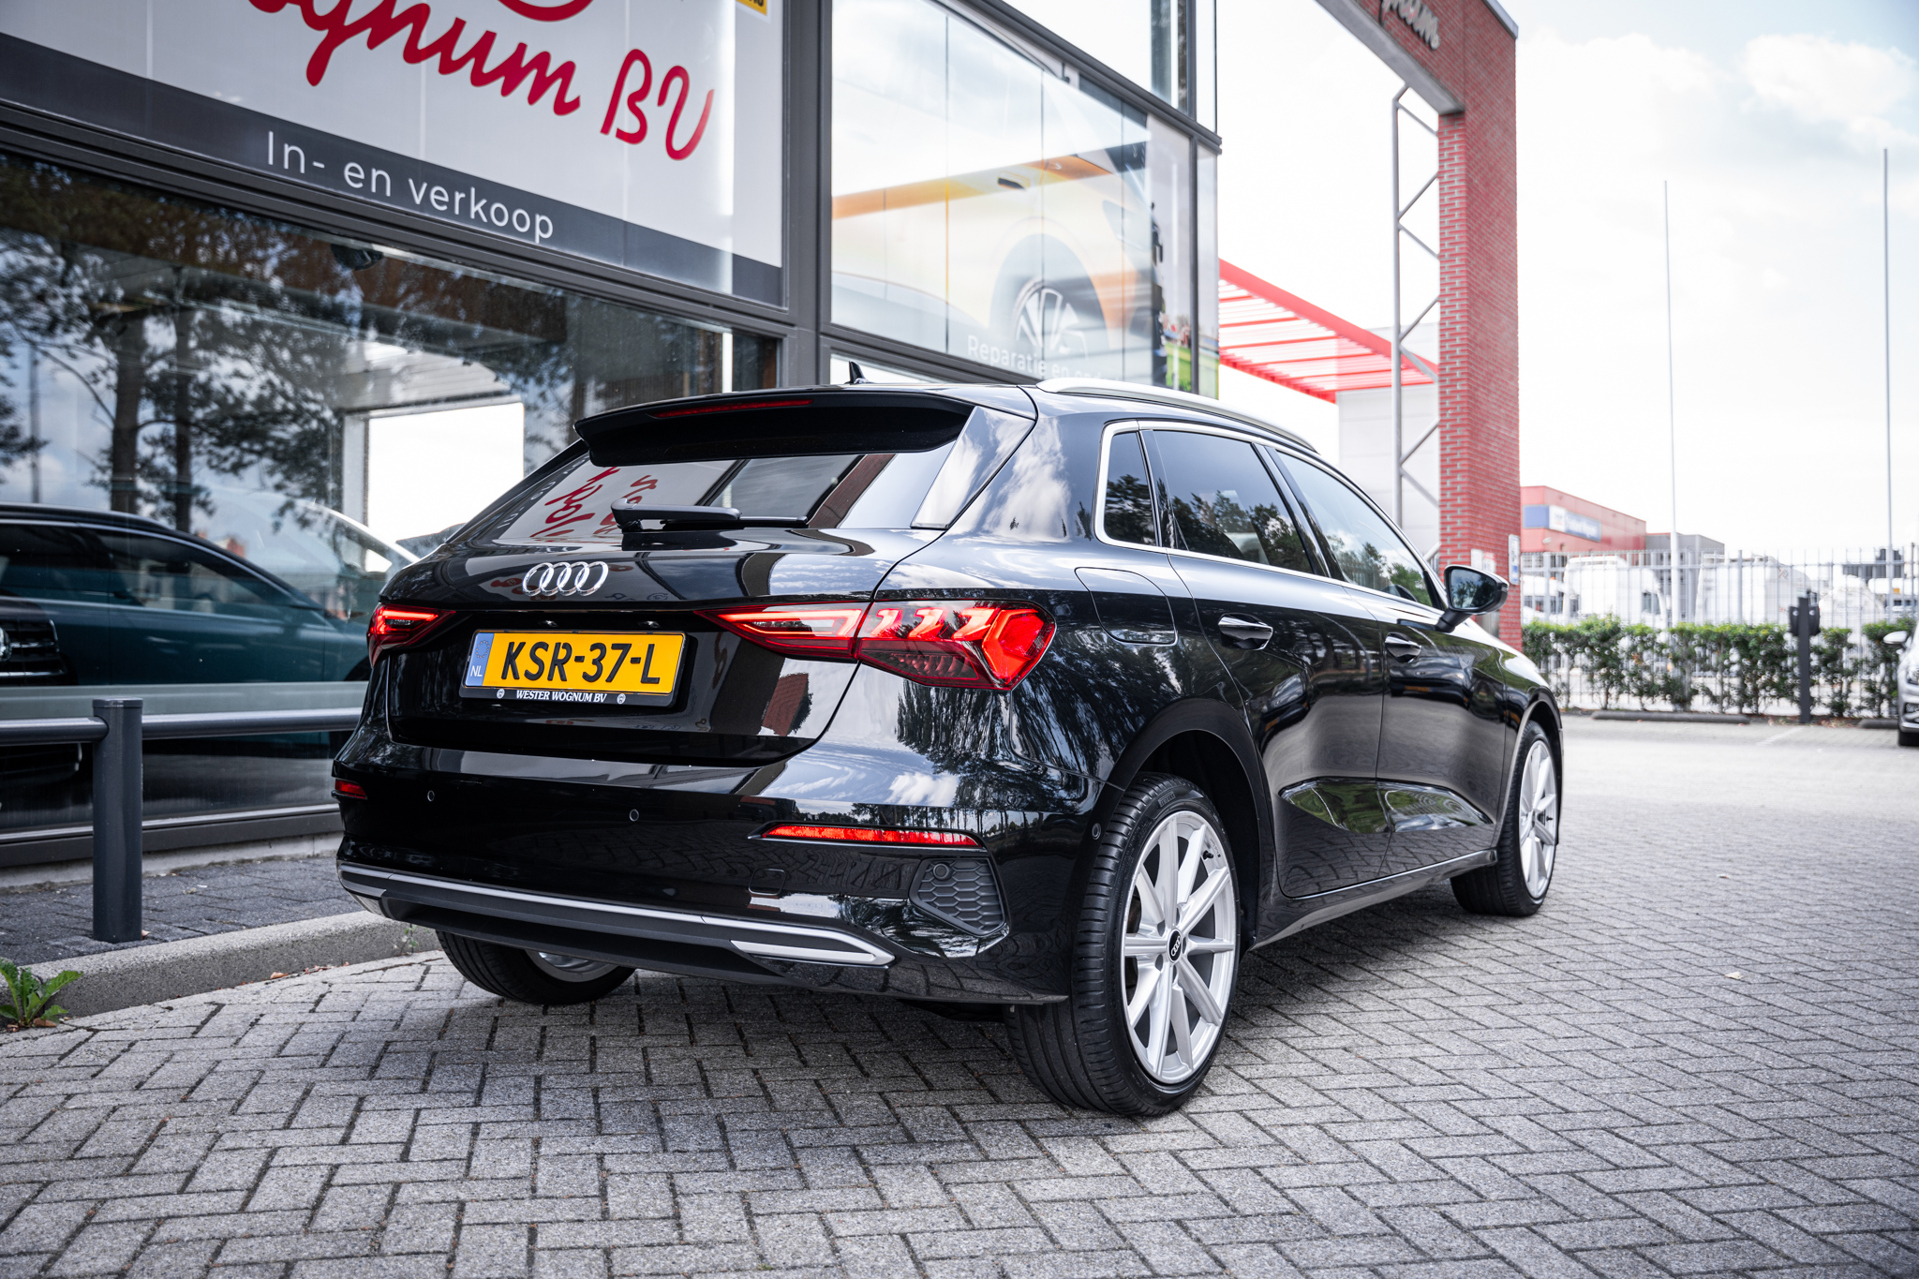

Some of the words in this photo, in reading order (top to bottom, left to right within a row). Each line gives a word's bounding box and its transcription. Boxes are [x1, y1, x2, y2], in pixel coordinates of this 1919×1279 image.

[247, 0, 581, 117] gnum
[599, 48, 715, 161] BV
[267, 130, 326, 174] In-
[343, 161, 392, 197] en
[407, 177, 554, 244] verkoop
[967, 334, 1048, 377] Reparatie
[469, 664, 484, 678] NL
[500, 640, 661, 685] KSR-37-L
[516, 689, 551, 700] WESTER
[551, 691, 593, 702] WOGNUM
[593, 693, 608, 703] BV
